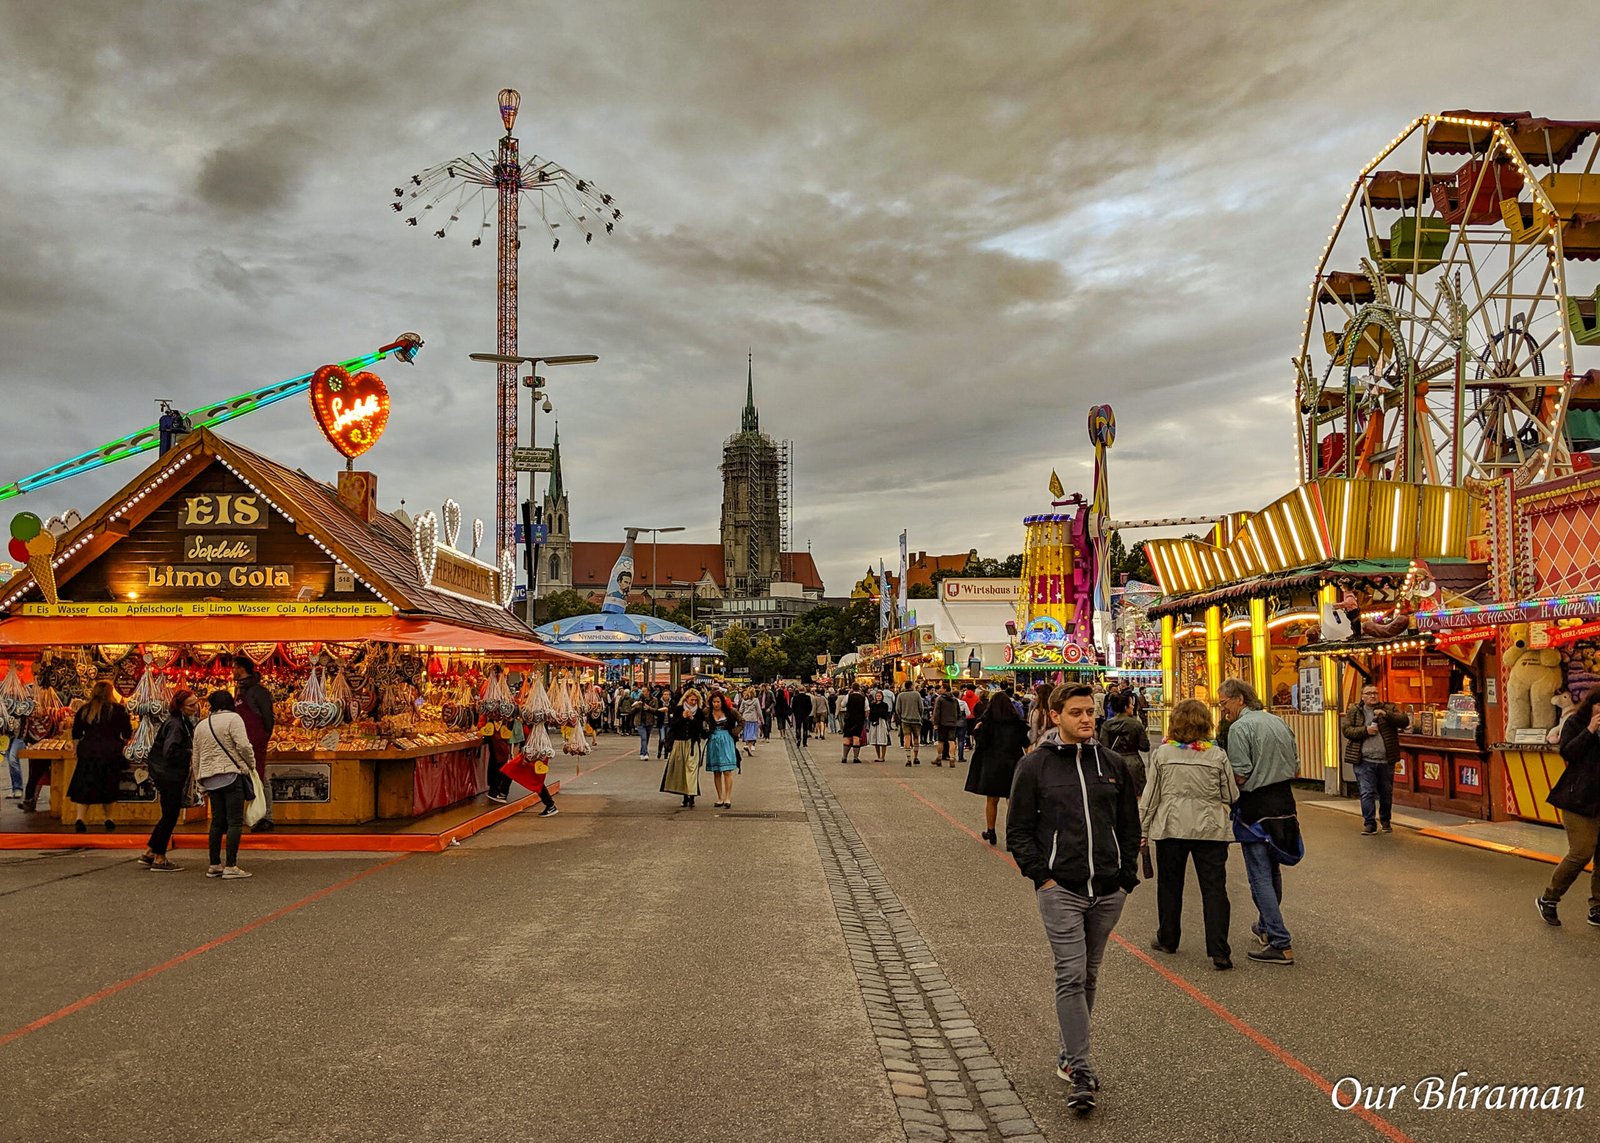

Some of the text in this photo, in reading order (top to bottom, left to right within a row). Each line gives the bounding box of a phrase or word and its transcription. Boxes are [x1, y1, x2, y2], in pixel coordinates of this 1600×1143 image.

[185, 495, 260, 525] EIS
[147, 565, 290, 587] Limo Cola
[961, 584, 1011, 596] Wirtshaus
[36, 605, 49, 614] Eis
[57, 605, 90, 614] Wasser
[98, 604, 119, 614] Cola
[126, 604, 184, 614] Apfelschorle
[192, 604, 205, 613] Eis
[209, 604, 232, 613] Limo
[238, 604, 270, 613] Wasser
[276, 604, 297, 613] Cola
[302, 605, 360, 614] Apfelschorle
[364, 605, 377, 614] Eis
[1477, 608, 1527, 625] SCHIESSEN
